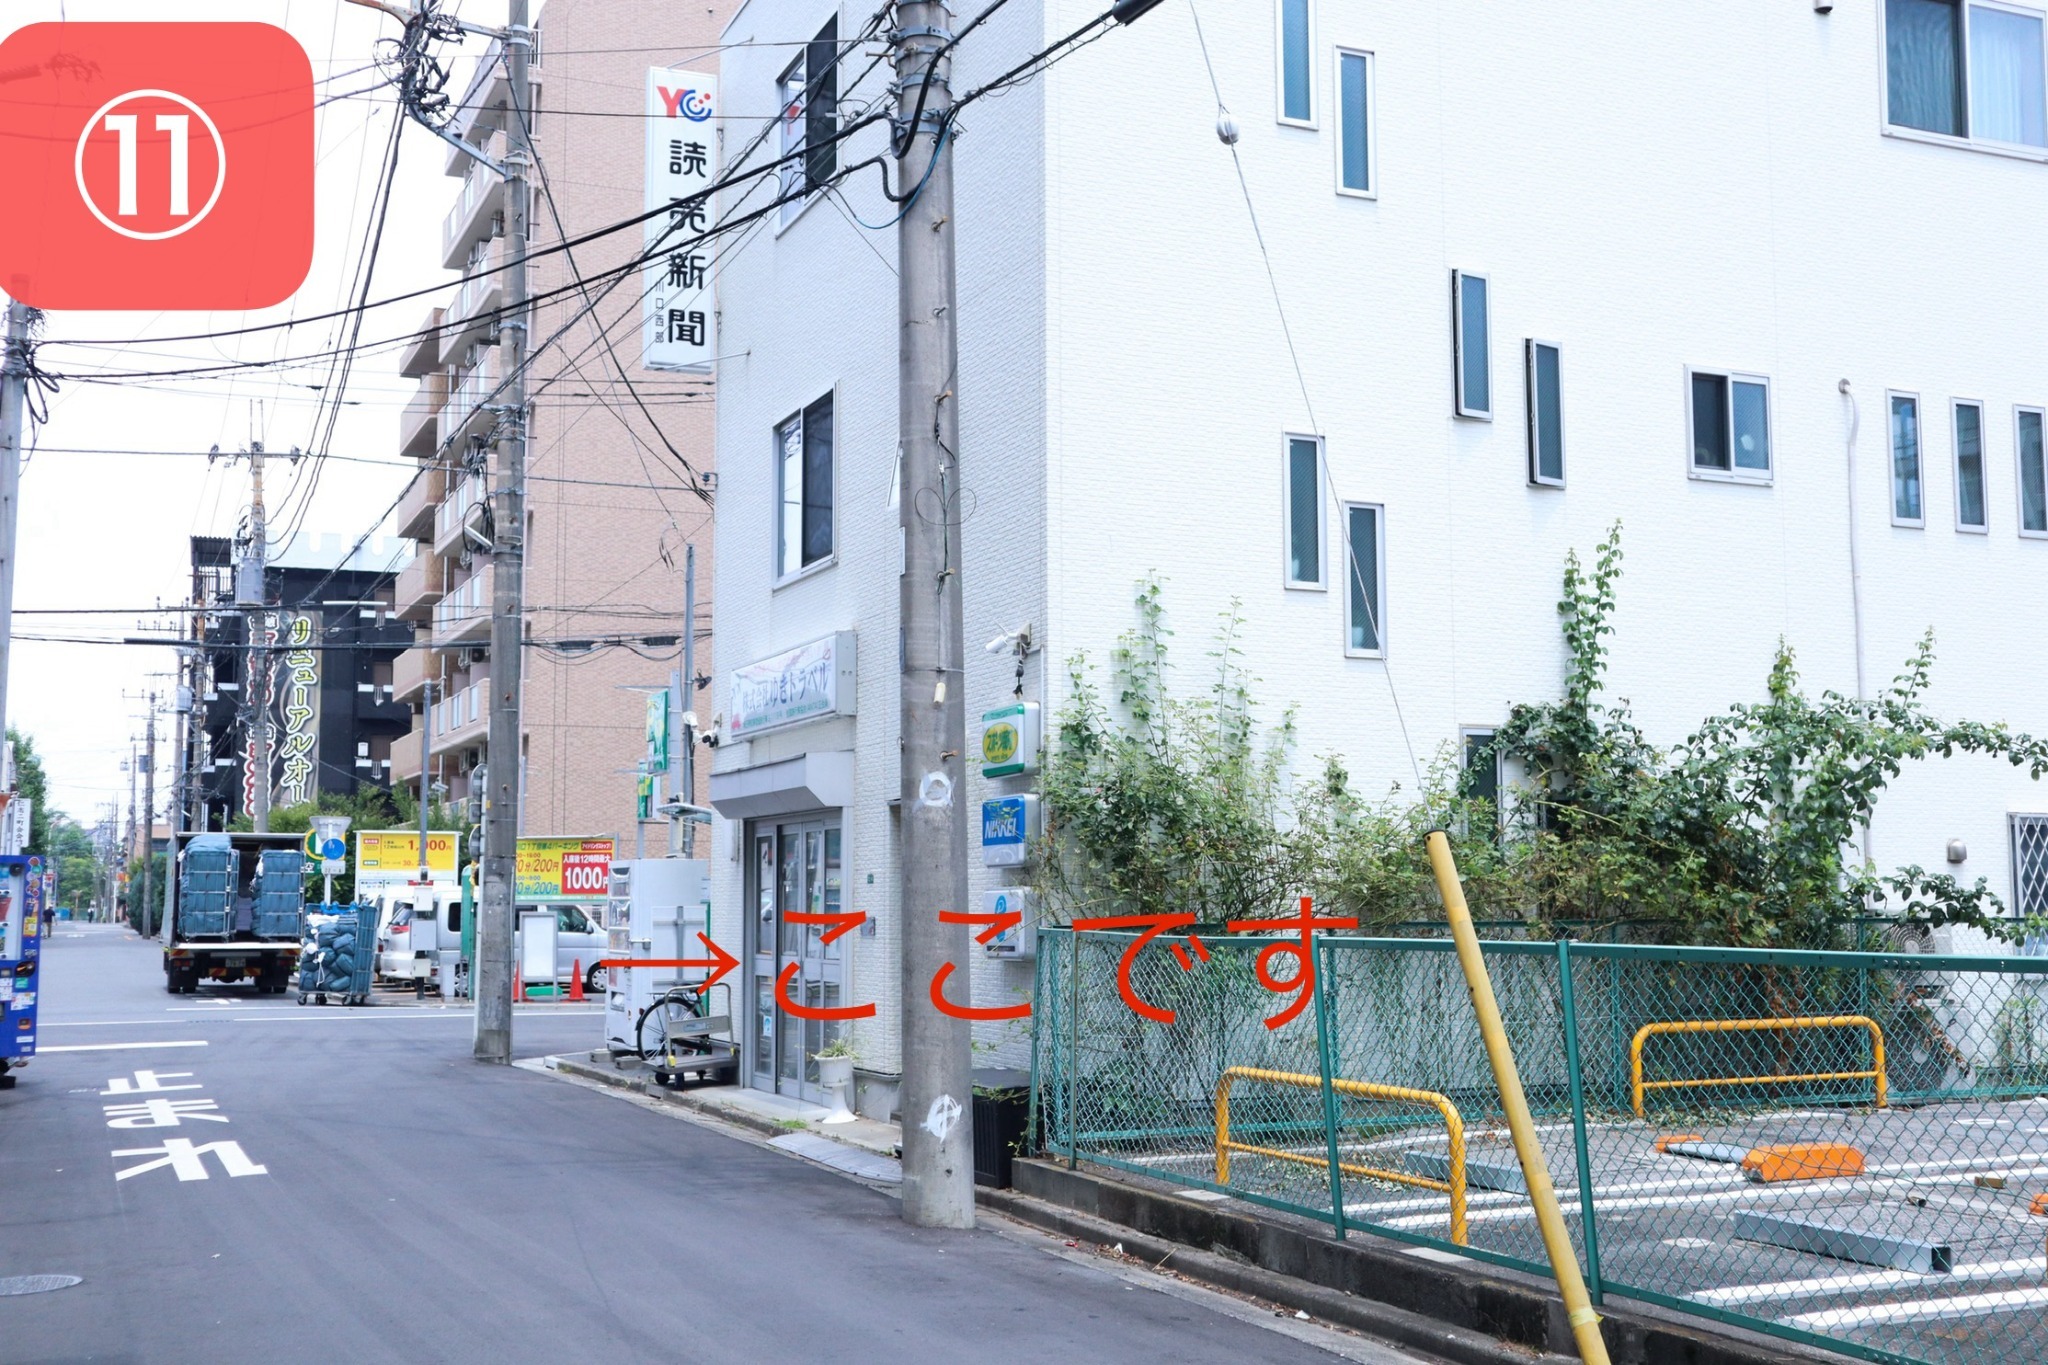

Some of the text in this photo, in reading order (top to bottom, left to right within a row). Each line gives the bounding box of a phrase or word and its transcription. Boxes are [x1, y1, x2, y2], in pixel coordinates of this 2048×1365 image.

[668, 139, 707, 347] 読売新聞
[985, 818, 1018, 839] NIKKEI
[516, 859, 559, 873] 0分/200円
[516, 881, 559, 895] 0分/200円
[565, 866, 609, 890] 1000円
[99, 1070, 268, 1182] 止まれ
